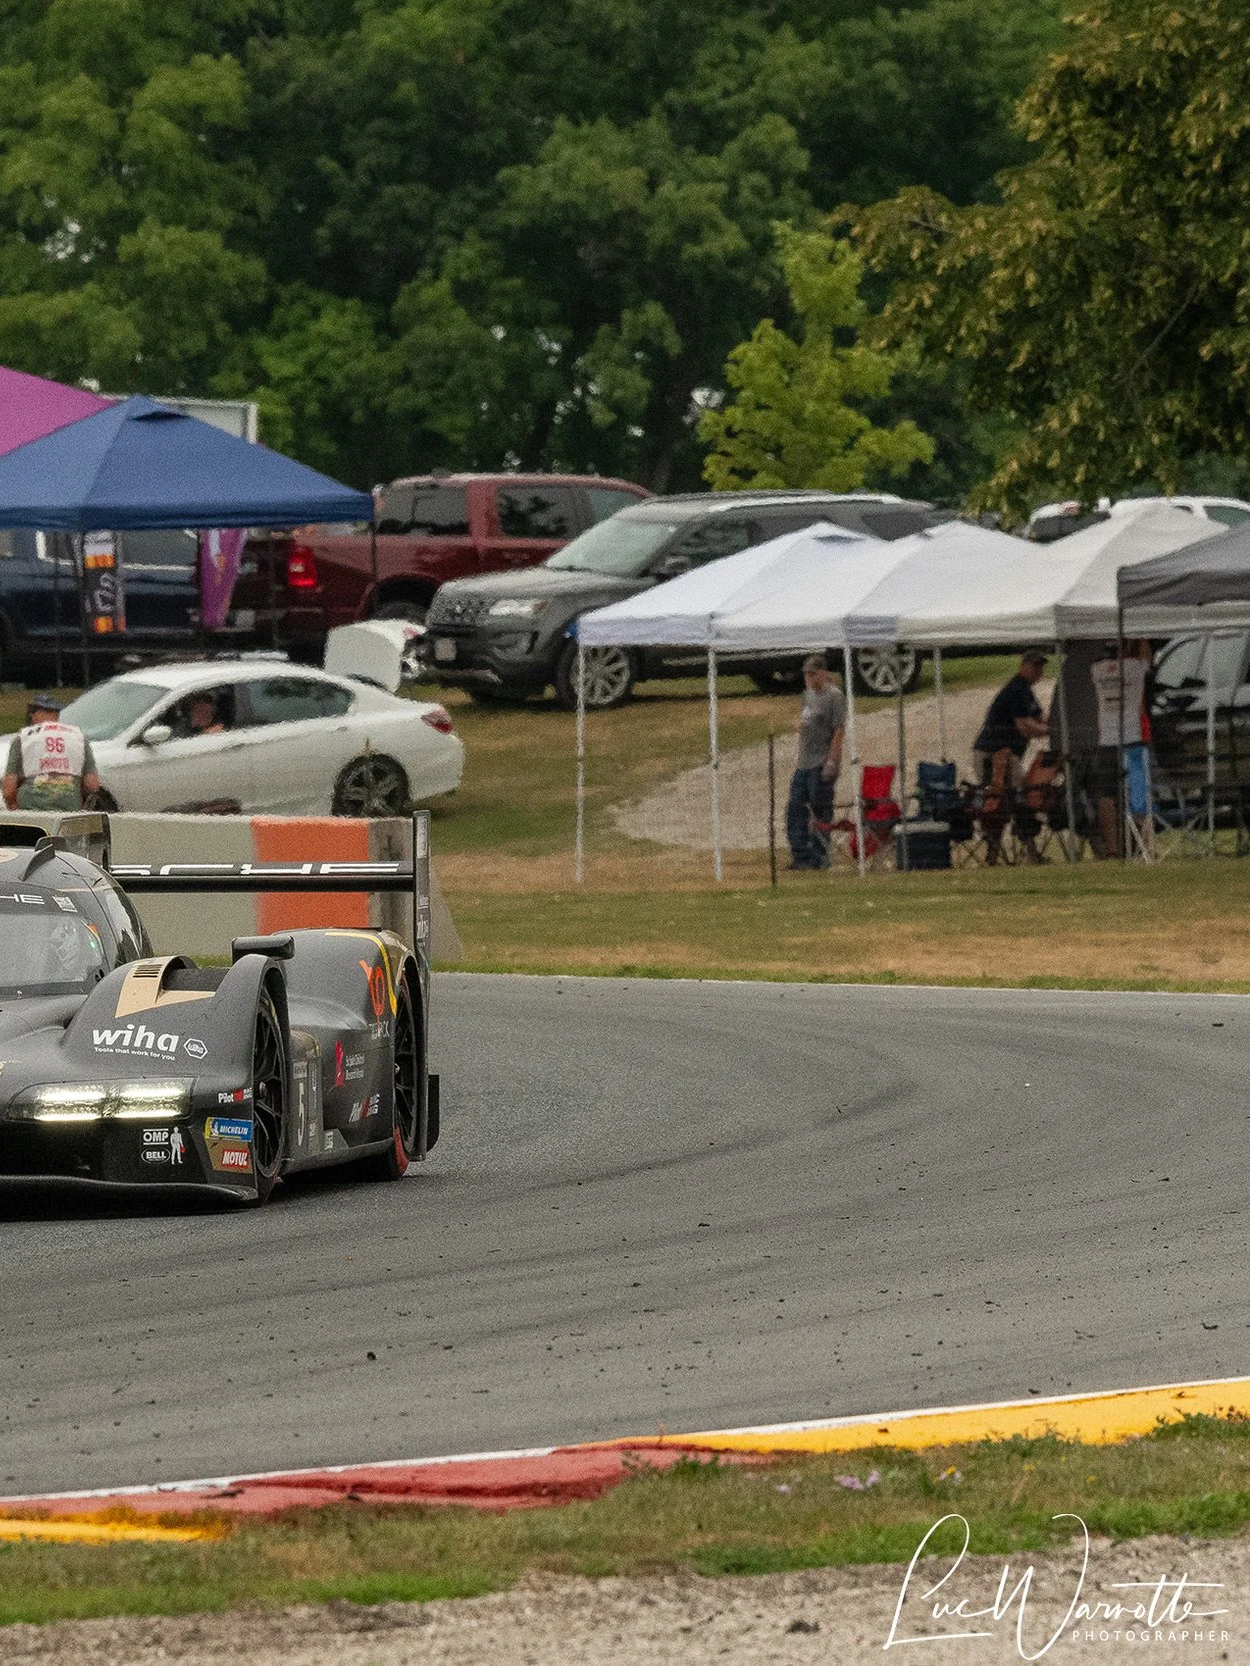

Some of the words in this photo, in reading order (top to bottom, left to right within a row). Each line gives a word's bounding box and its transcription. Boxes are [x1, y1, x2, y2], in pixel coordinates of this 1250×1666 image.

[92, 1024, 180, 1053] wiha
[161, 1053, 175, 1061] you
[219, 1125, 249, 1135] MICHELIN
[143, 1131, 169, 1142] OMP
[146, 1150, 167, 1159] BELL
[222, 1150, 248, 1166] MOTUL
